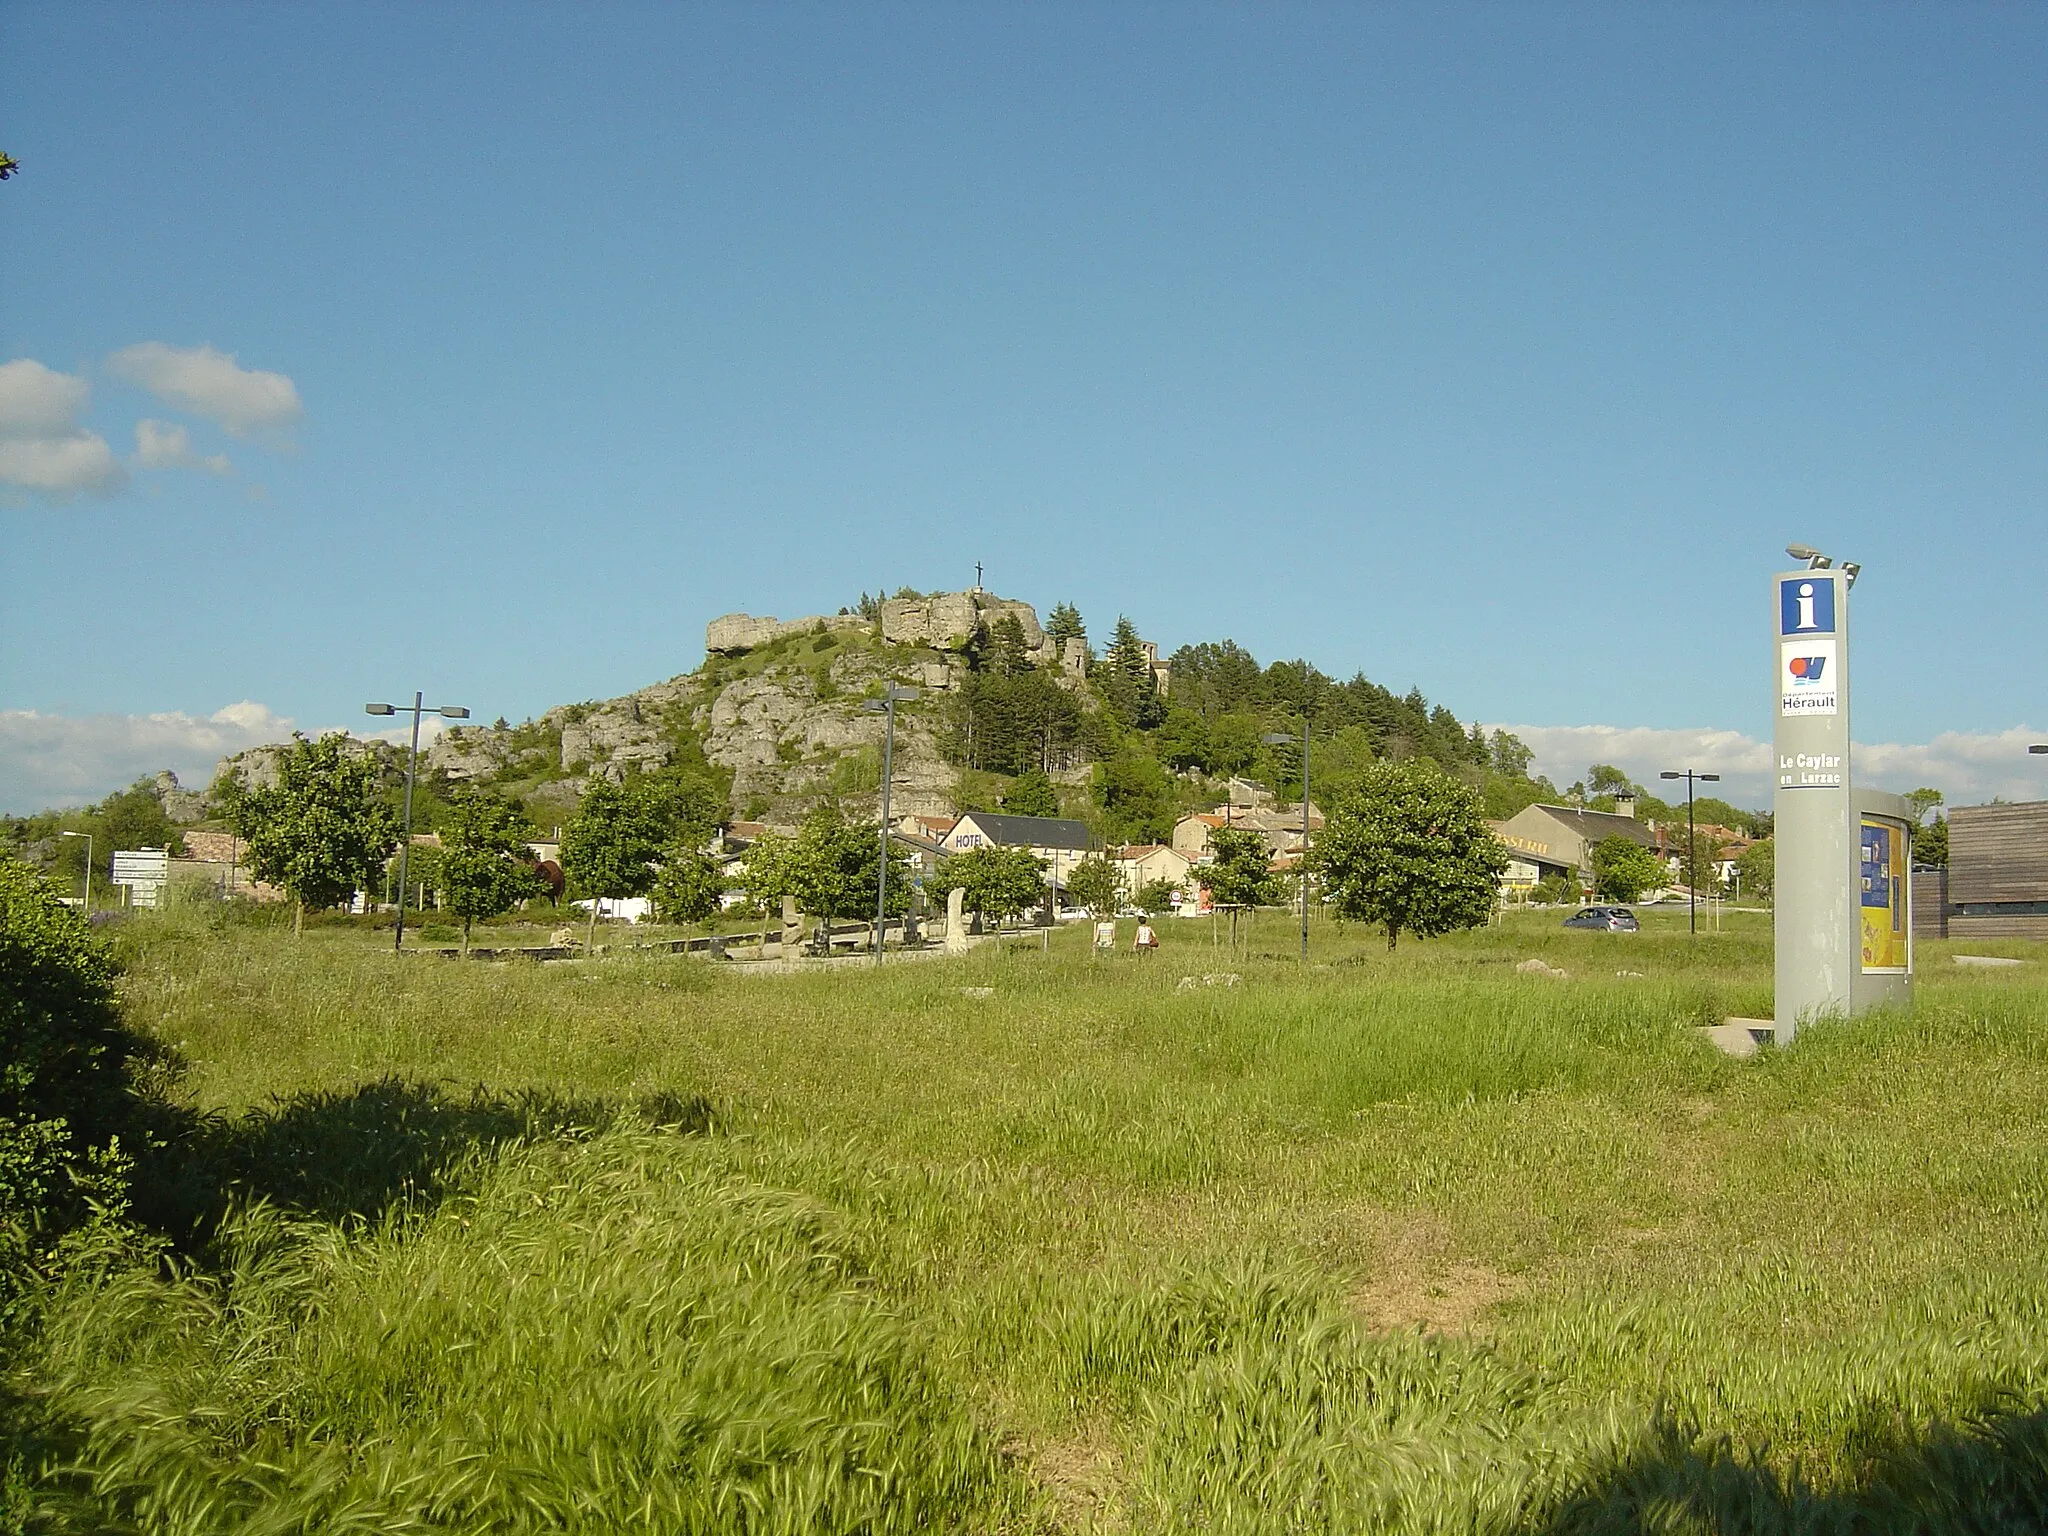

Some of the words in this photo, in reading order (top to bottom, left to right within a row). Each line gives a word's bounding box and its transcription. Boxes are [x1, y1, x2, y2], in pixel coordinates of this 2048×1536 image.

[1796, 583, 1818, 629] i
[1782, 696, 1835, 709] Hérault
[1780, 754, 1794, 769] Le
[1796, 753, 1841, 770] Caylar
[1780, 775, 1792, 785] en
[1801, 771, 1841, 784] Larzac
[956, 834, 983, 848] HOTEL
